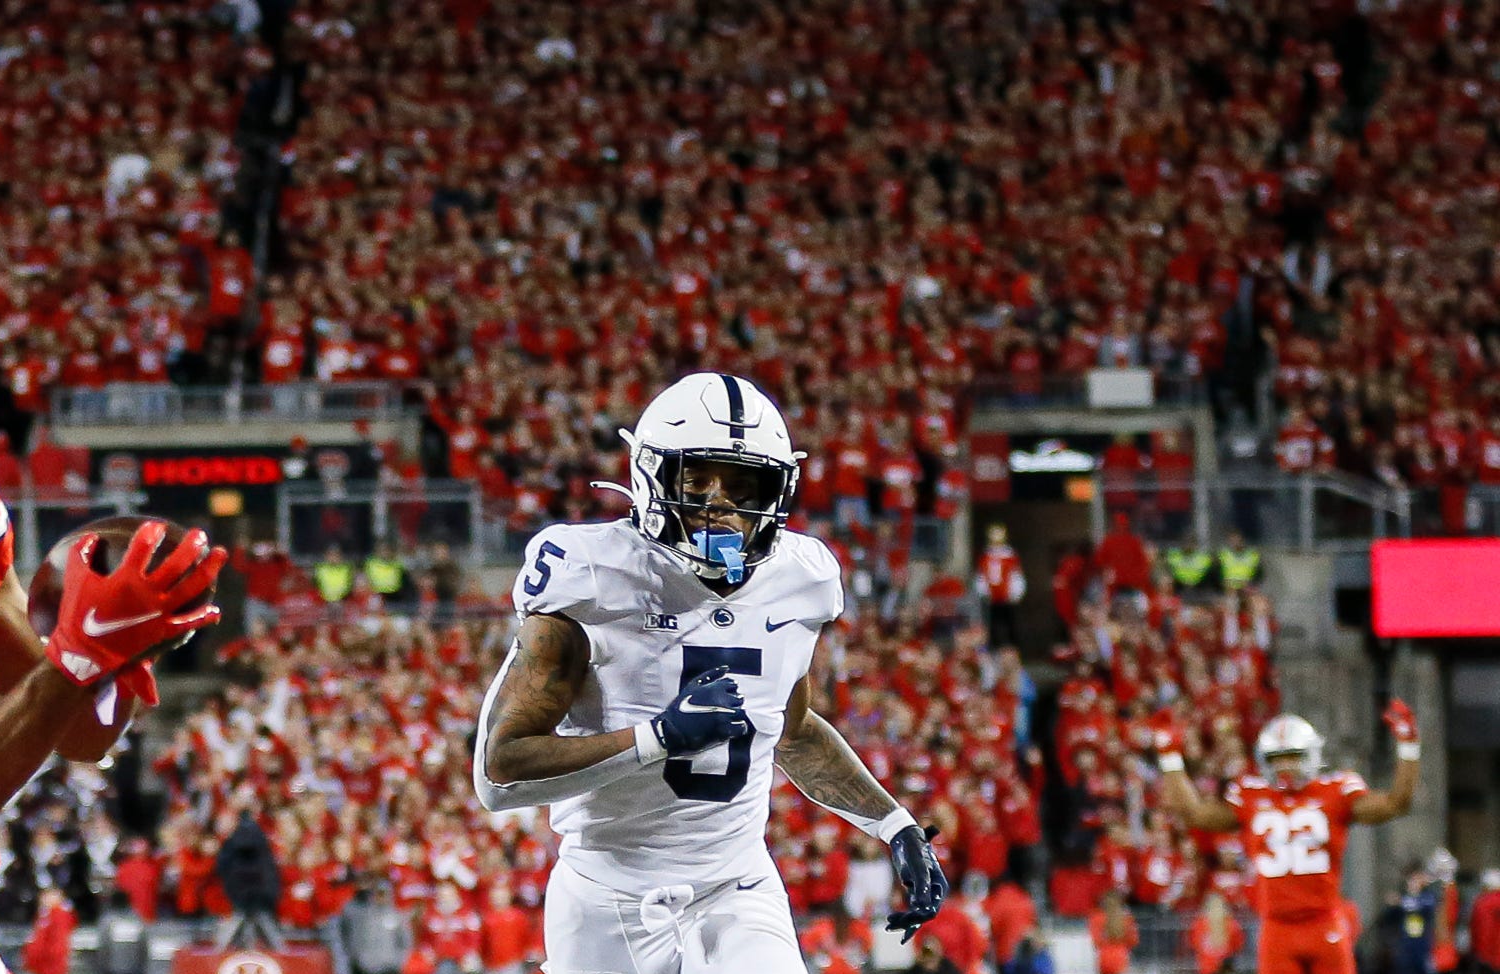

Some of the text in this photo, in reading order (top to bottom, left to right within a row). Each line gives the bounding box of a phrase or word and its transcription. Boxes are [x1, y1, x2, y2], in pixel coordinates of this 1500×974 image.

[523, 540, 567, 597] 5
[662, 644, 763, 804] 5
[1251, 808, 1331, 879] 32
